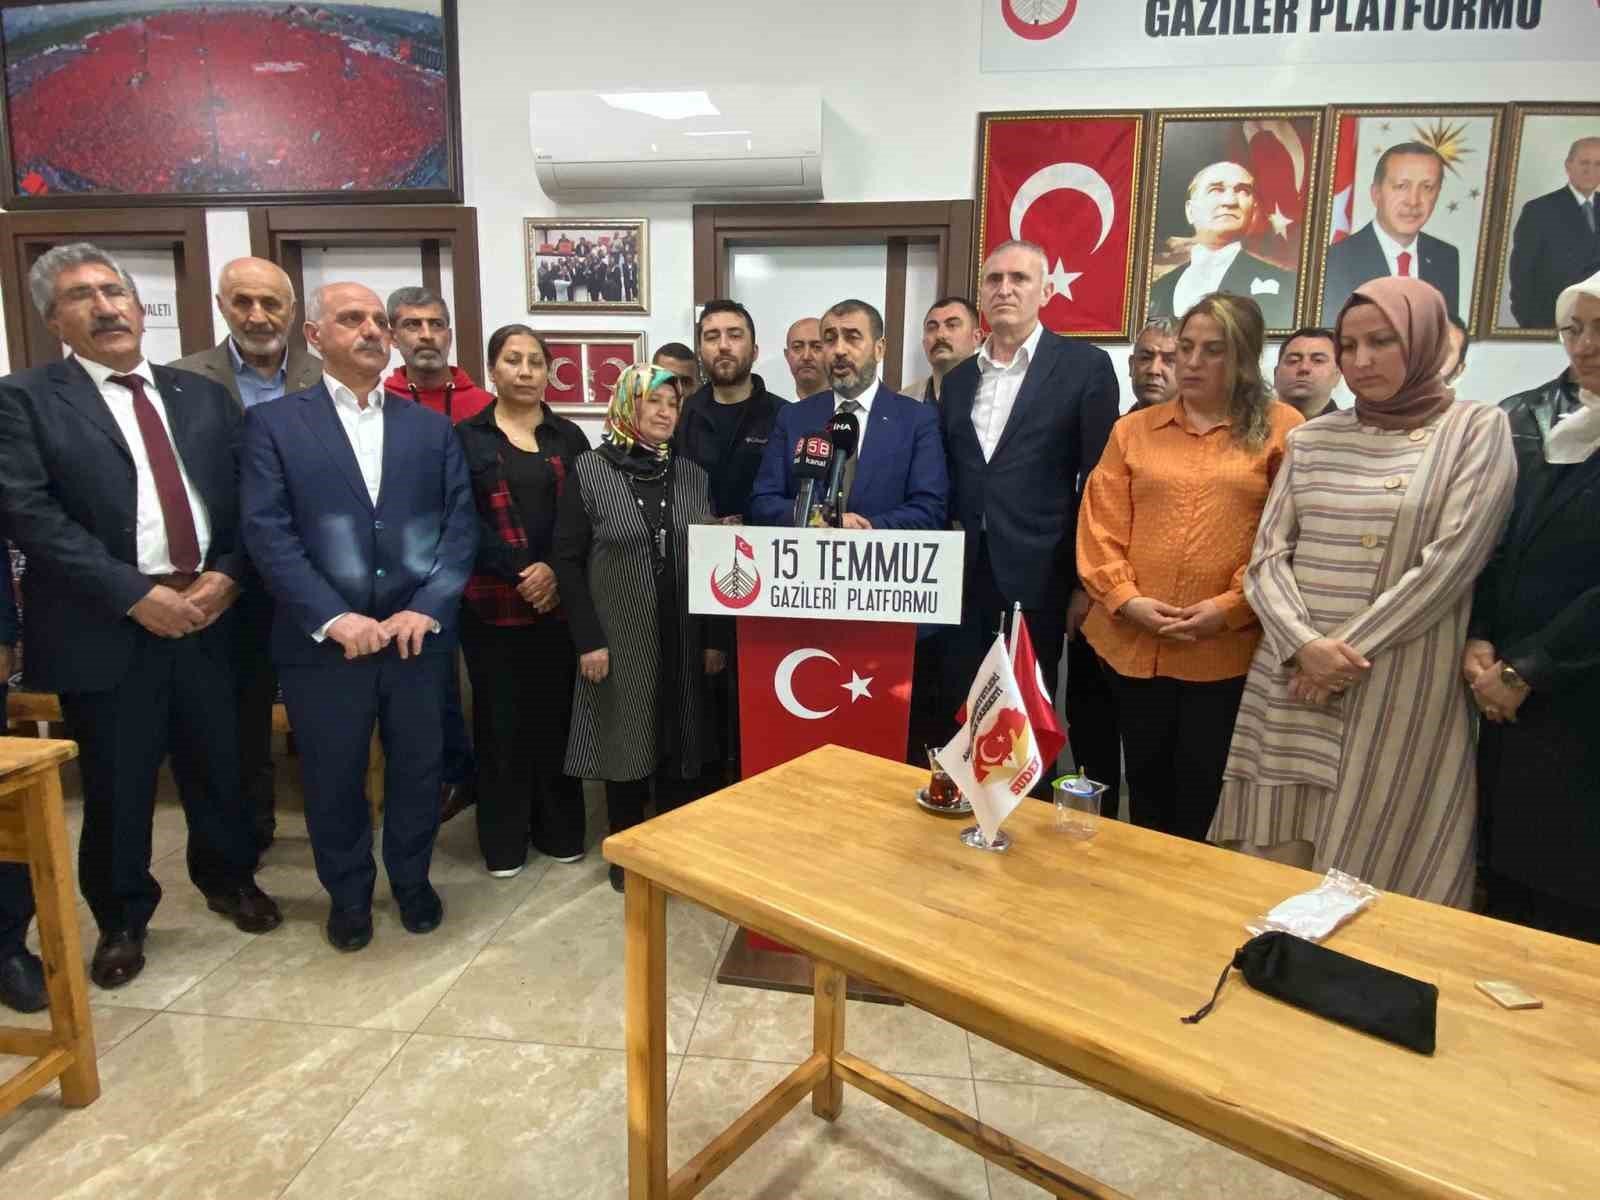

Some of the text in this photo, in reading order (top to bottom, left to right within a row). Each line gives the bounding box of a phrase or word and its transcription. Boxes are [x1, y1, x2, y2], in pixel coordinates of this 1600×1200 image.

[771, 538, 940, 584] 15 TEMMUZ
[770, 581, 938, 614] GAZİLERİ PLATFORMU
